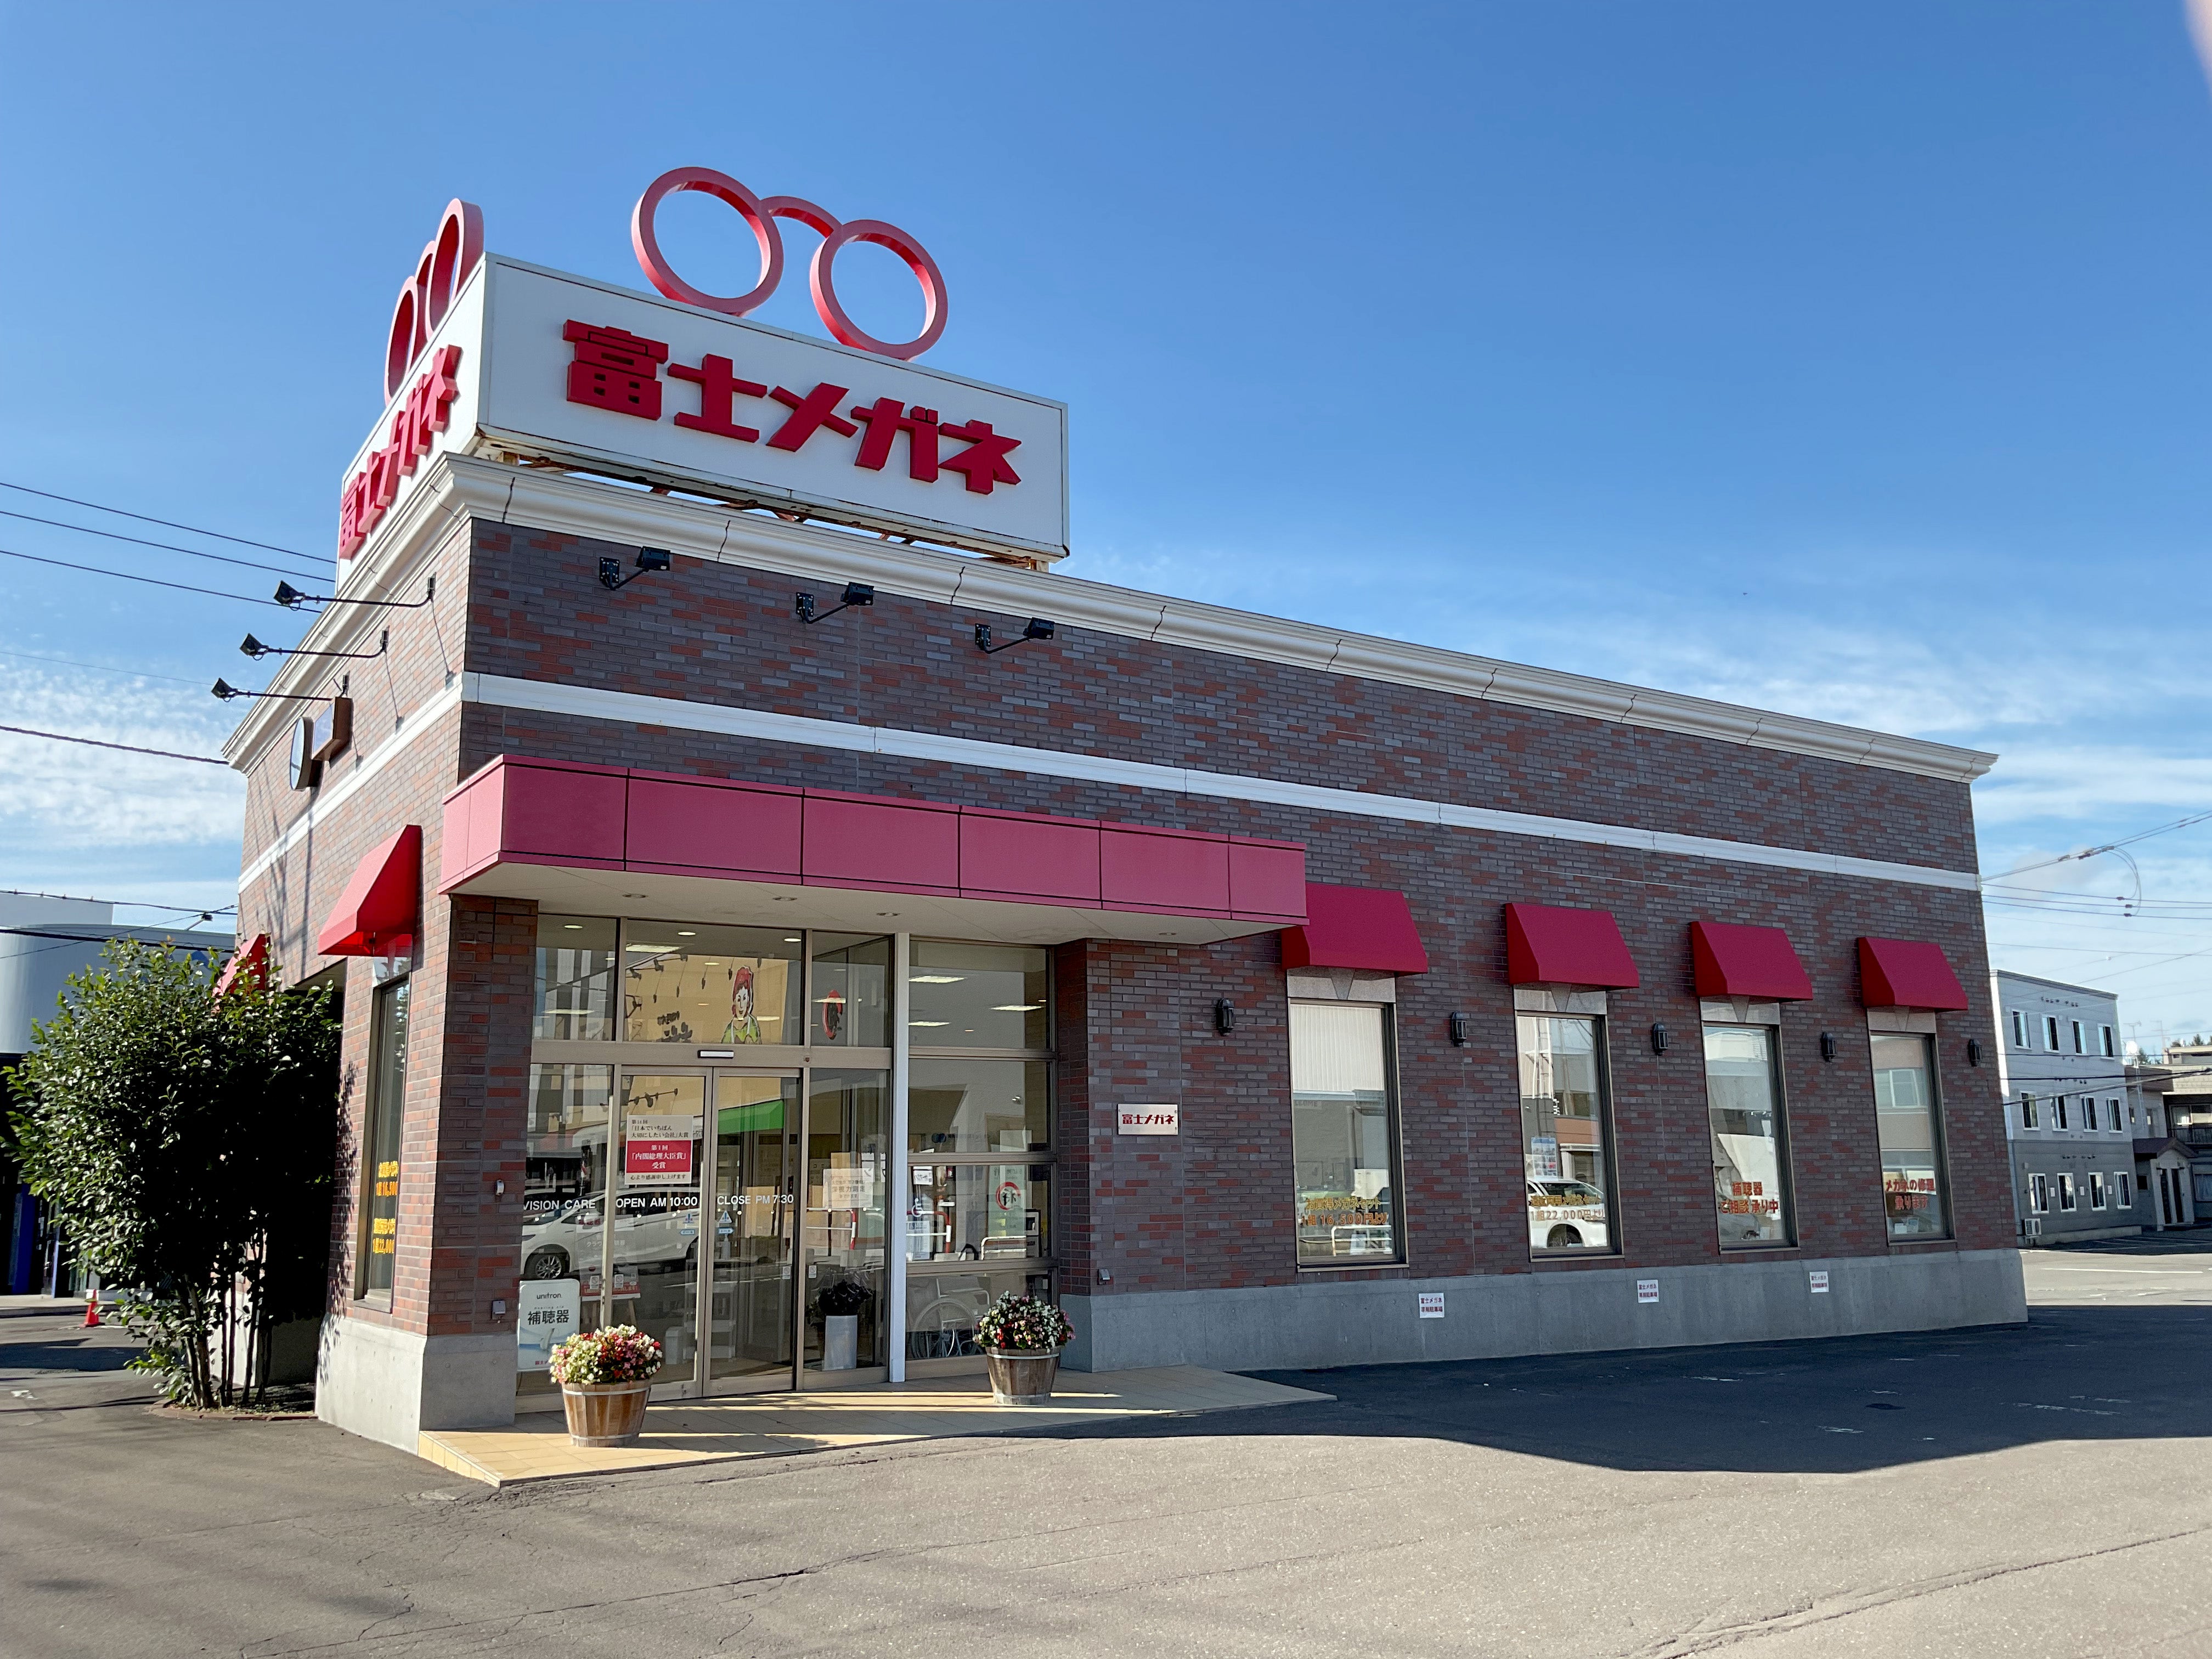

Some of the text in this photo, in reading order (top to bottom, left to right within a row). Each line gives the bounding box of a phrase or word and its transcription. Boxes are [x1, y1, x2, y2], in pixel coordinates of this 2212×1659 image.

[563, 319, 1022, 495] 富士メガネ
[1122, 1114, 1174, 1124] 富士メガネ
[1886, 1178, 1936, 1192] メガネの修理
[523, 1199, 596, 1211] VISION CARE
[616, 1196, 698, 1208] OPEN AM 10:00
[717, 1194, 794, 1205] CLOSE PM 7:30
[528, 1309, 570, 1325] 補聴器
